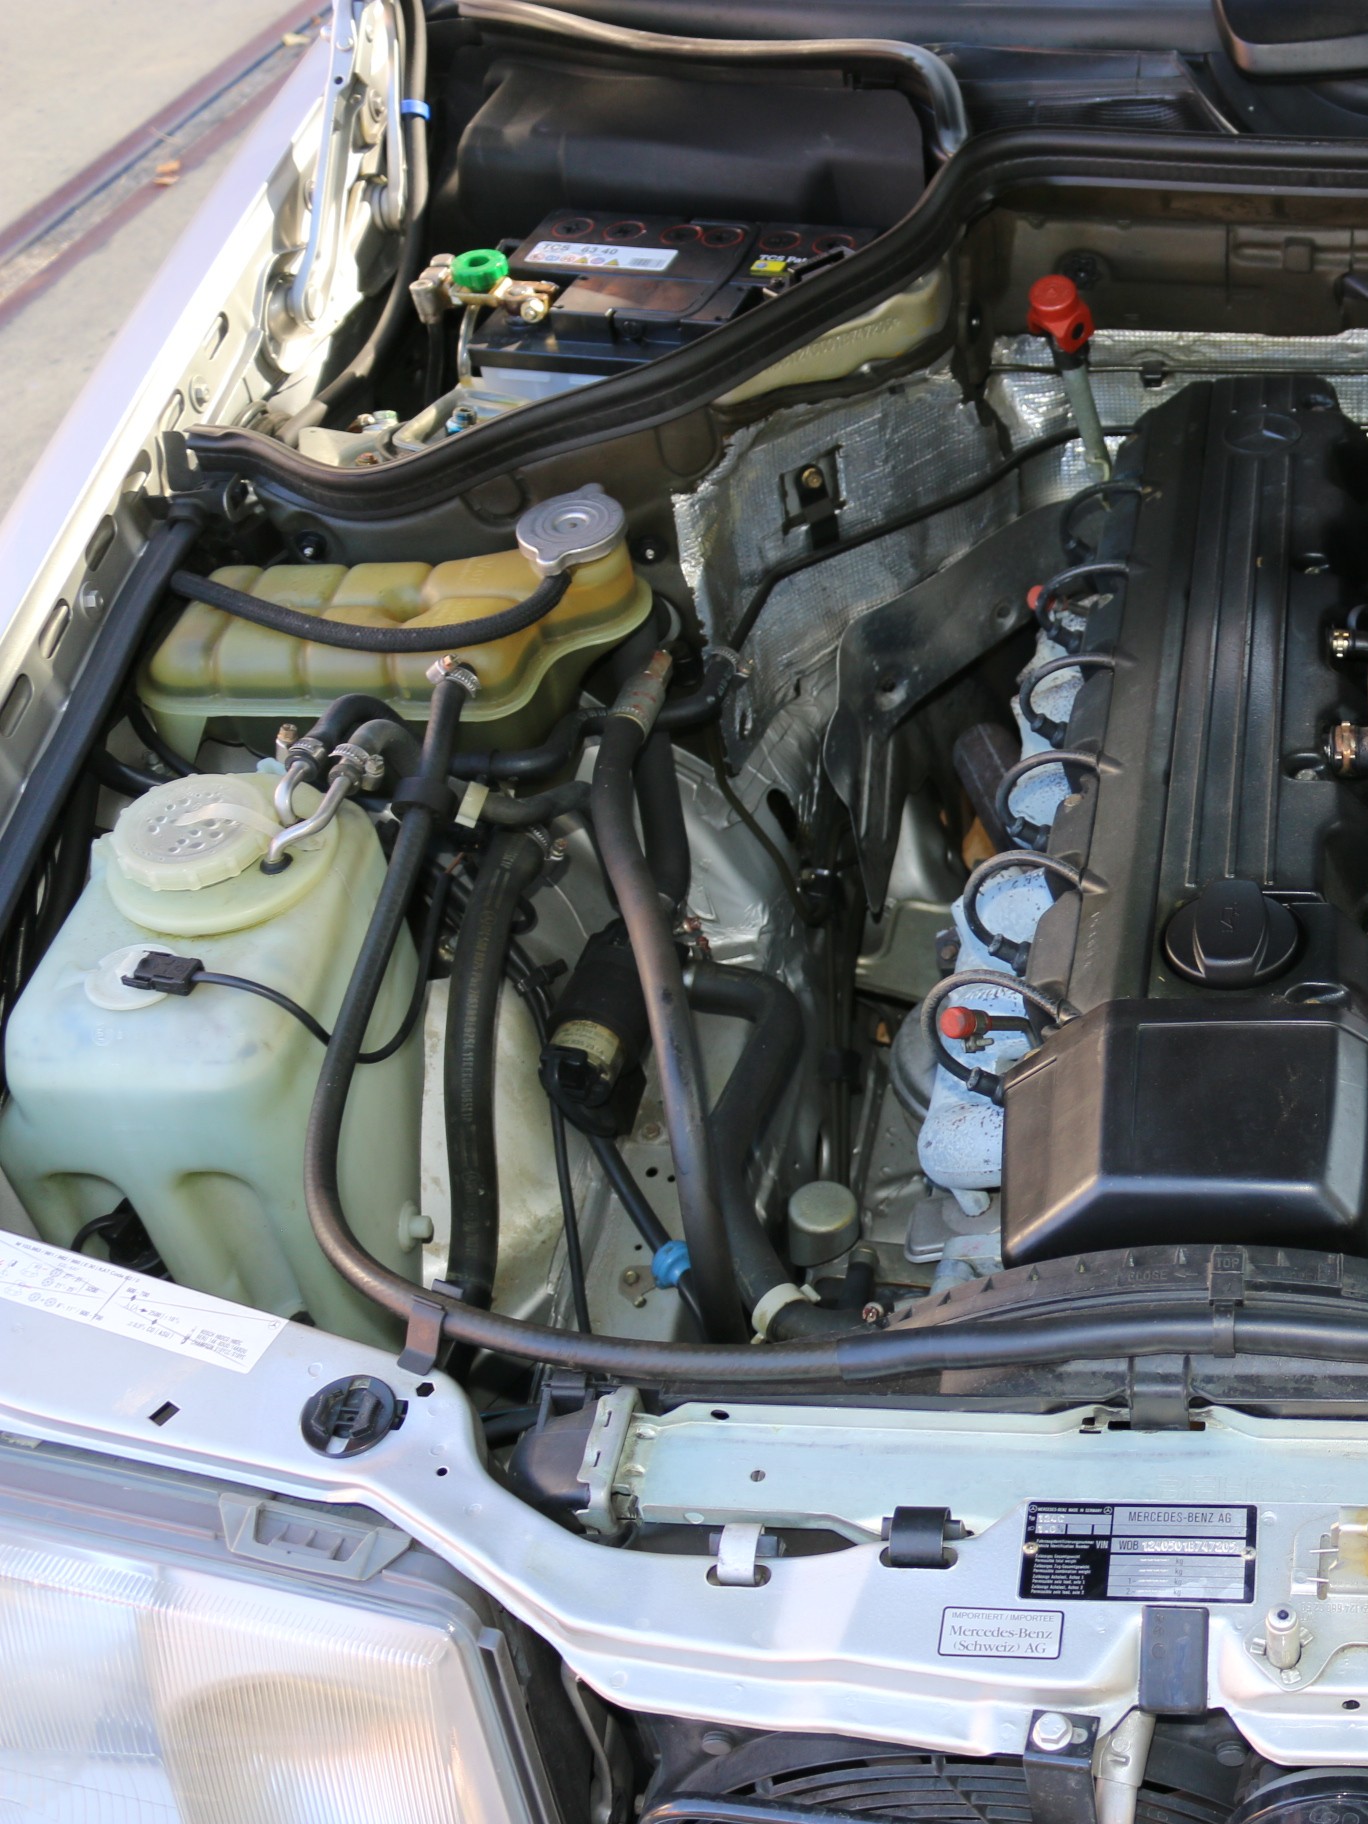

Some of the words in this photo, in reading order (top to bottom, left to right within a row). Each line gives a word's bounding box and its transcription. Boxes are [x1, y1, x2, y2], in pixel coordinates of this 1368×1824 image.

[543, 243, 571, 251] TCS
[760, 254, 785, 262] TCS
[1215, 1257, 1240, 1269] TOP
[1128, 1511, 1214, 1523] MERCEDES-BENZ
[1218, 1513, 1232, 1523] AG
[1095, 1540, 1109, 1549] VIN
[1119, 1540, 1139, 1551] WDB
[951, 1611, 1004, 1621] IMPORTIERT
[1010, 1614, 1055, 1622] IMPORTEE
[949, 1625, 1053, 1640] Mercedes-Benz
[953, 1640, 1020, 1653] (Schweiz)
[1024, 1642, 1046, 1654] AG
